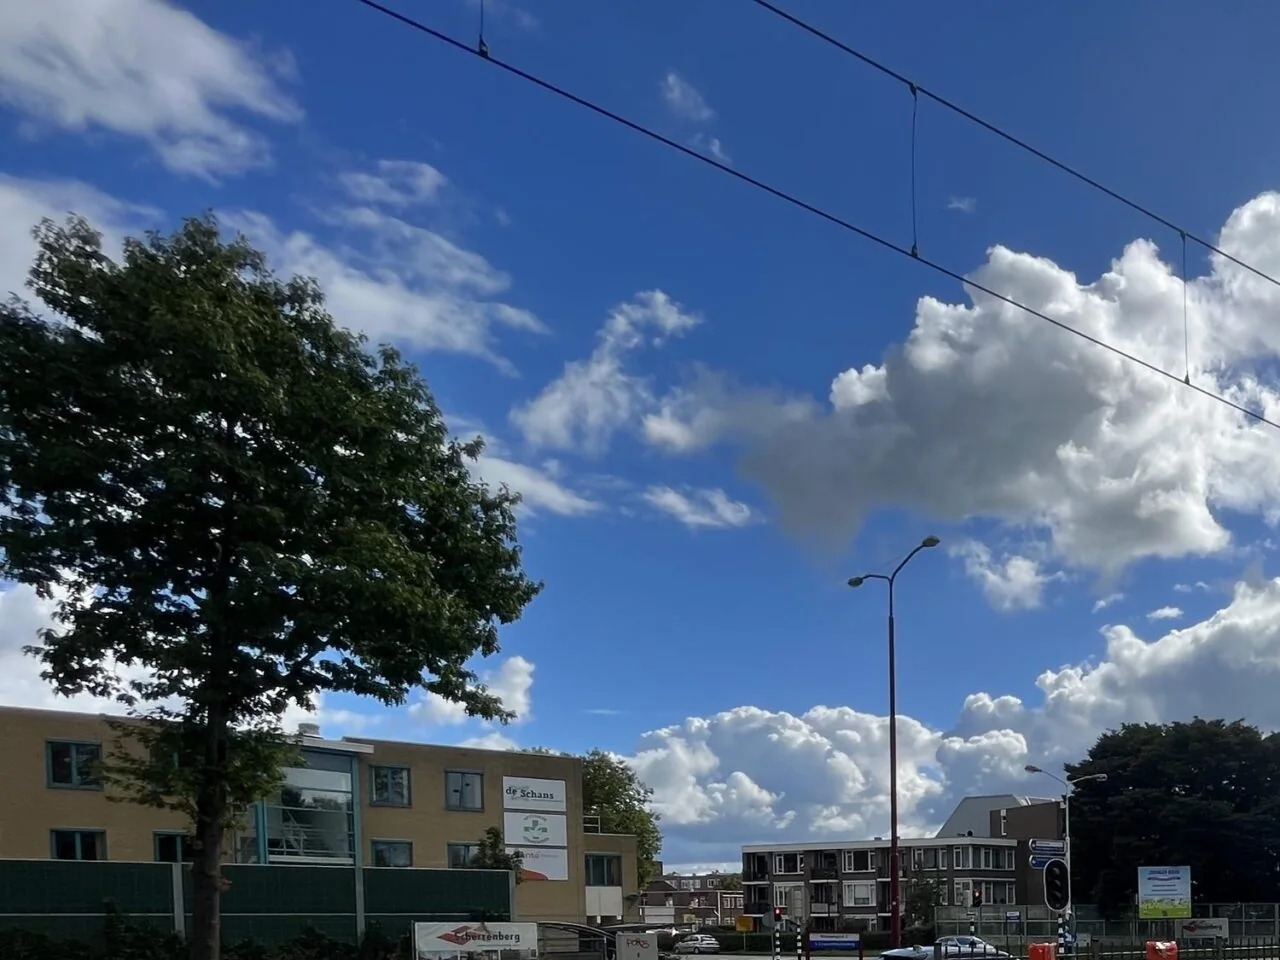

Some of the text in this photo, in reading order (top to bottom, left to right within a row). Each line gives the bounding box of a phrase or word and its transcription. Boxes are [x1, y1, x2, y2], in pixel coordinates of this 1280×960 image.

[505, 786, 554, 799] de Schans
[454, 931, 520, 943] Scherrenberg
